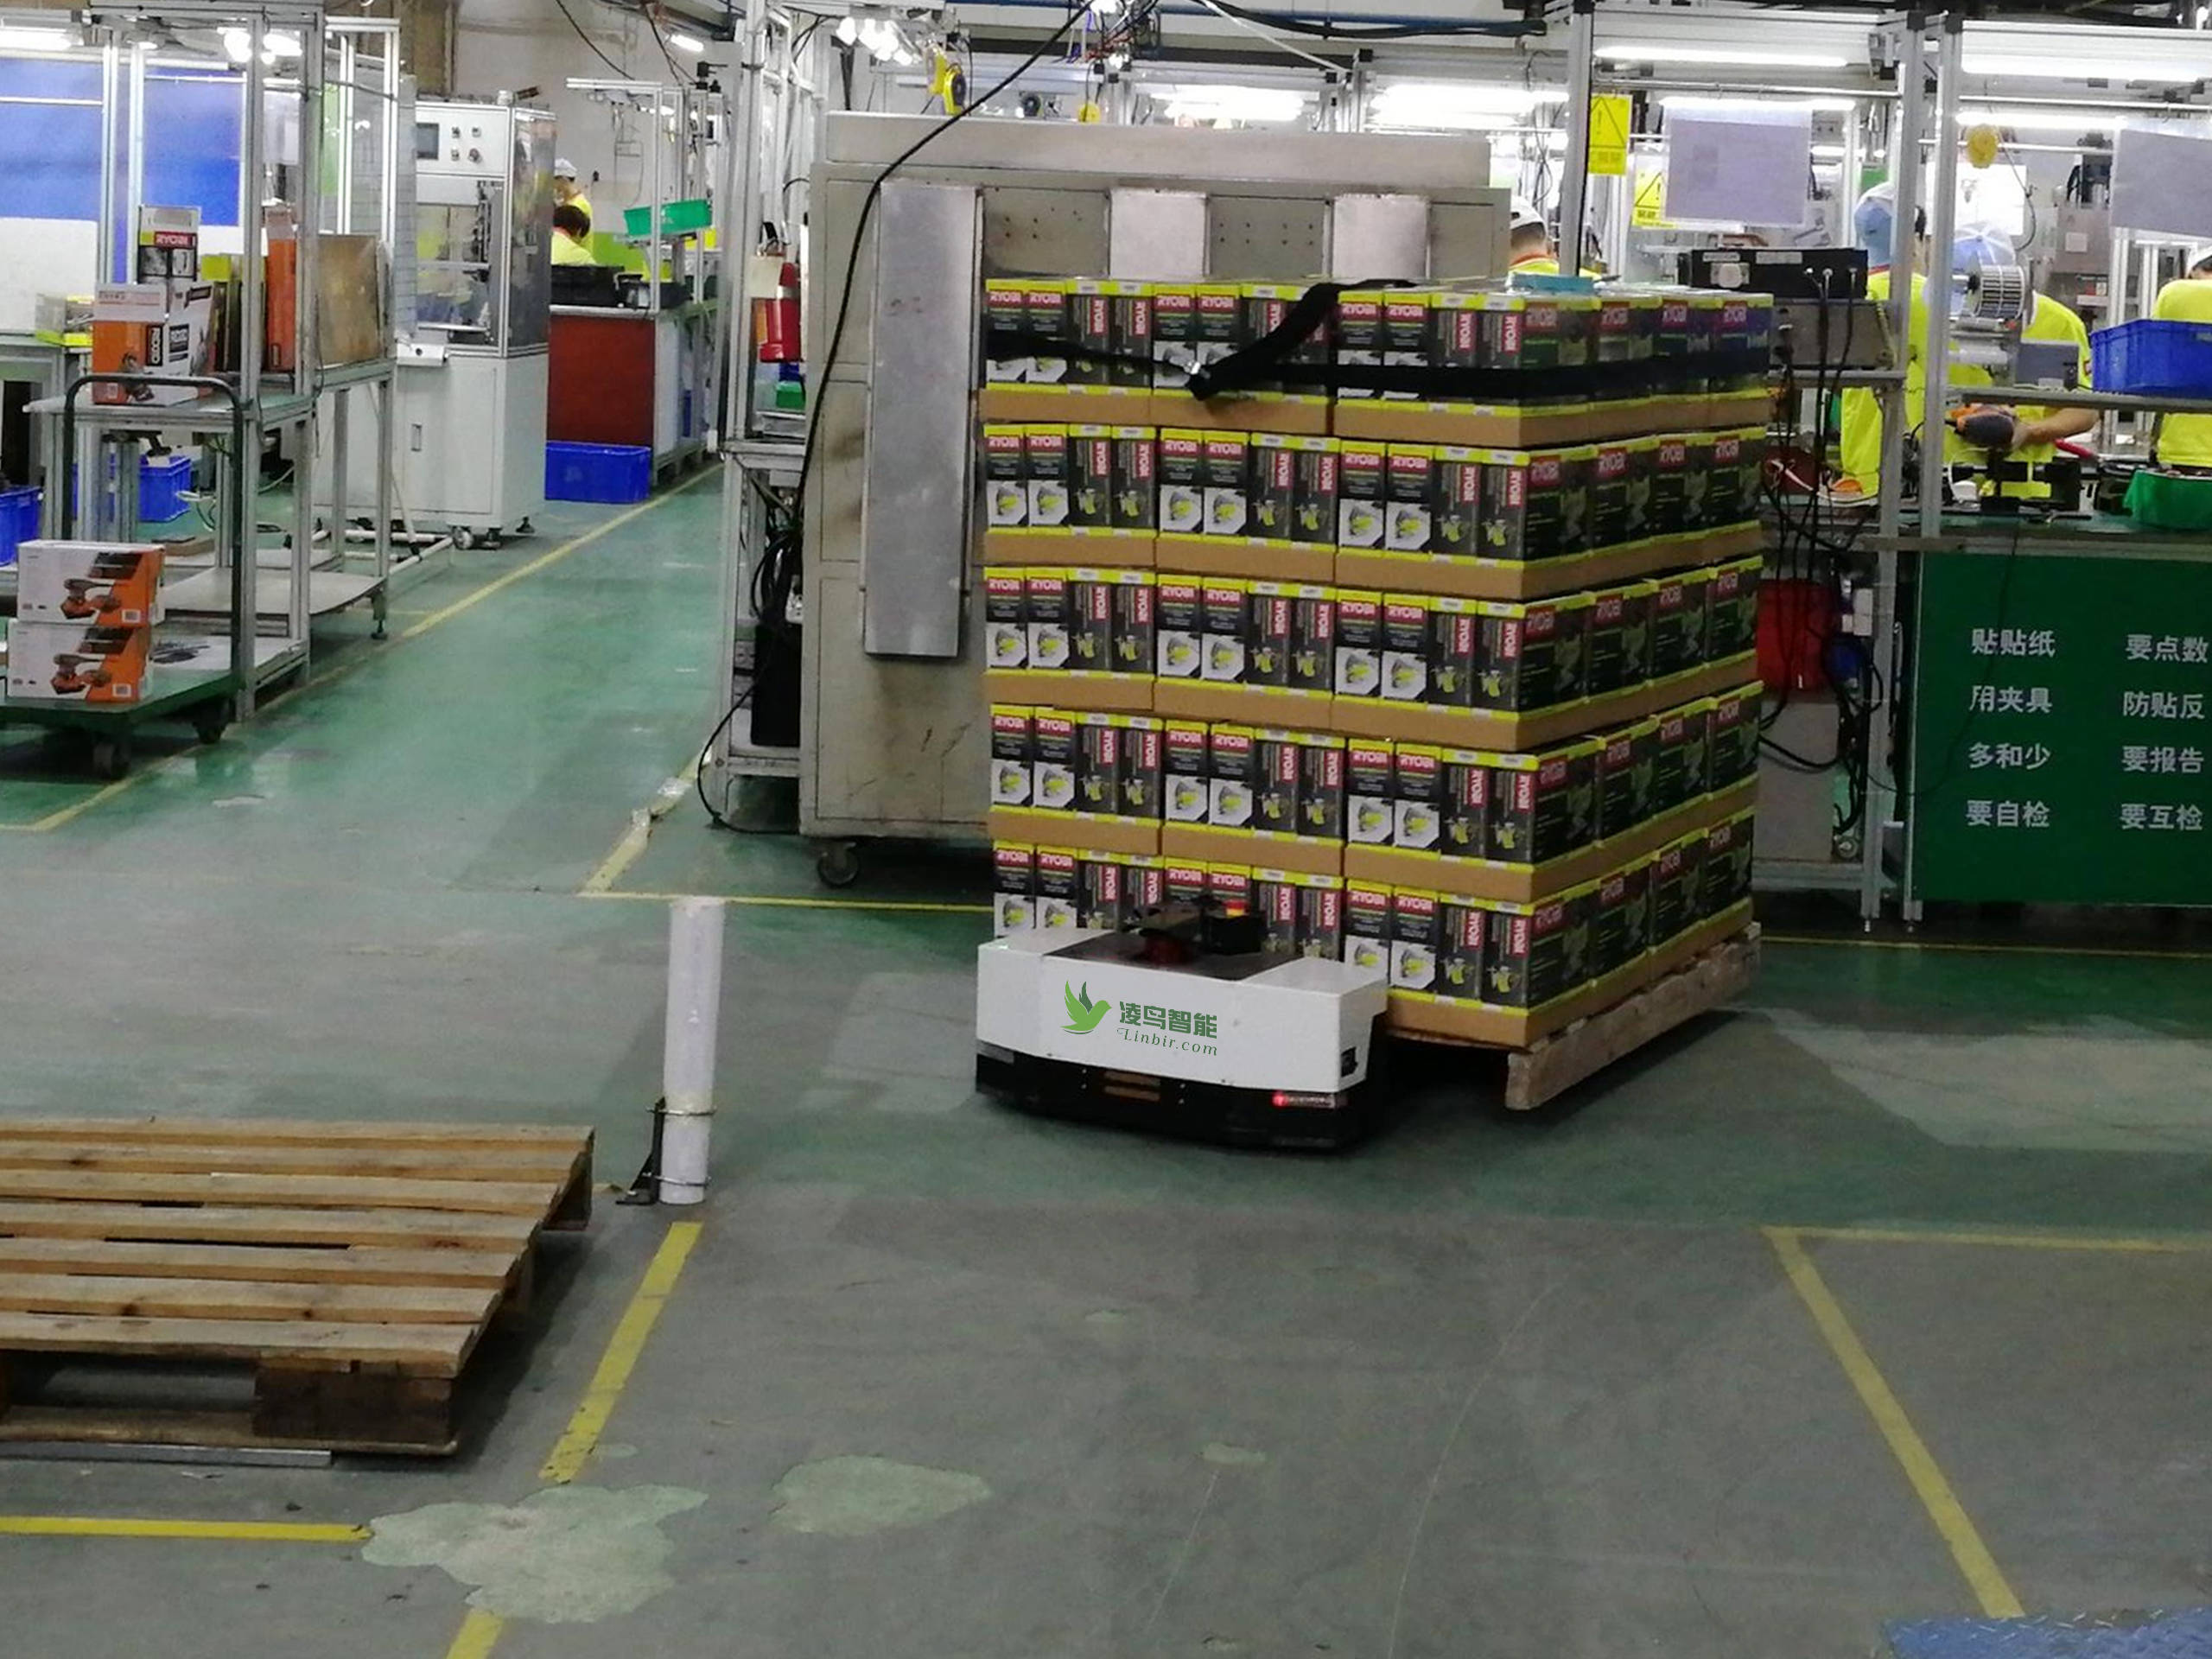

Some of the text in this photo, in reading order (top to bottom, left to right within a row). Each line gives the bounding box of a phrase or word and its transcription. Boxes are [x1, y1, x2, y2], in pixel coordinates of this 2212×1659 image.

[1972, 628, 2209, 663] 贴贴纸 要点数
[1969, 685, 2205, 719] 用夹具 防贴反
[1969, 742, 2204, 773] 多和少 要报告
[1967, 800, 2203, 830] 要自检 要互检
[1120, 1001, 1217, 1039] 凌鸟智能
[1116, 1027, 1217, 1056] Linbir.com
